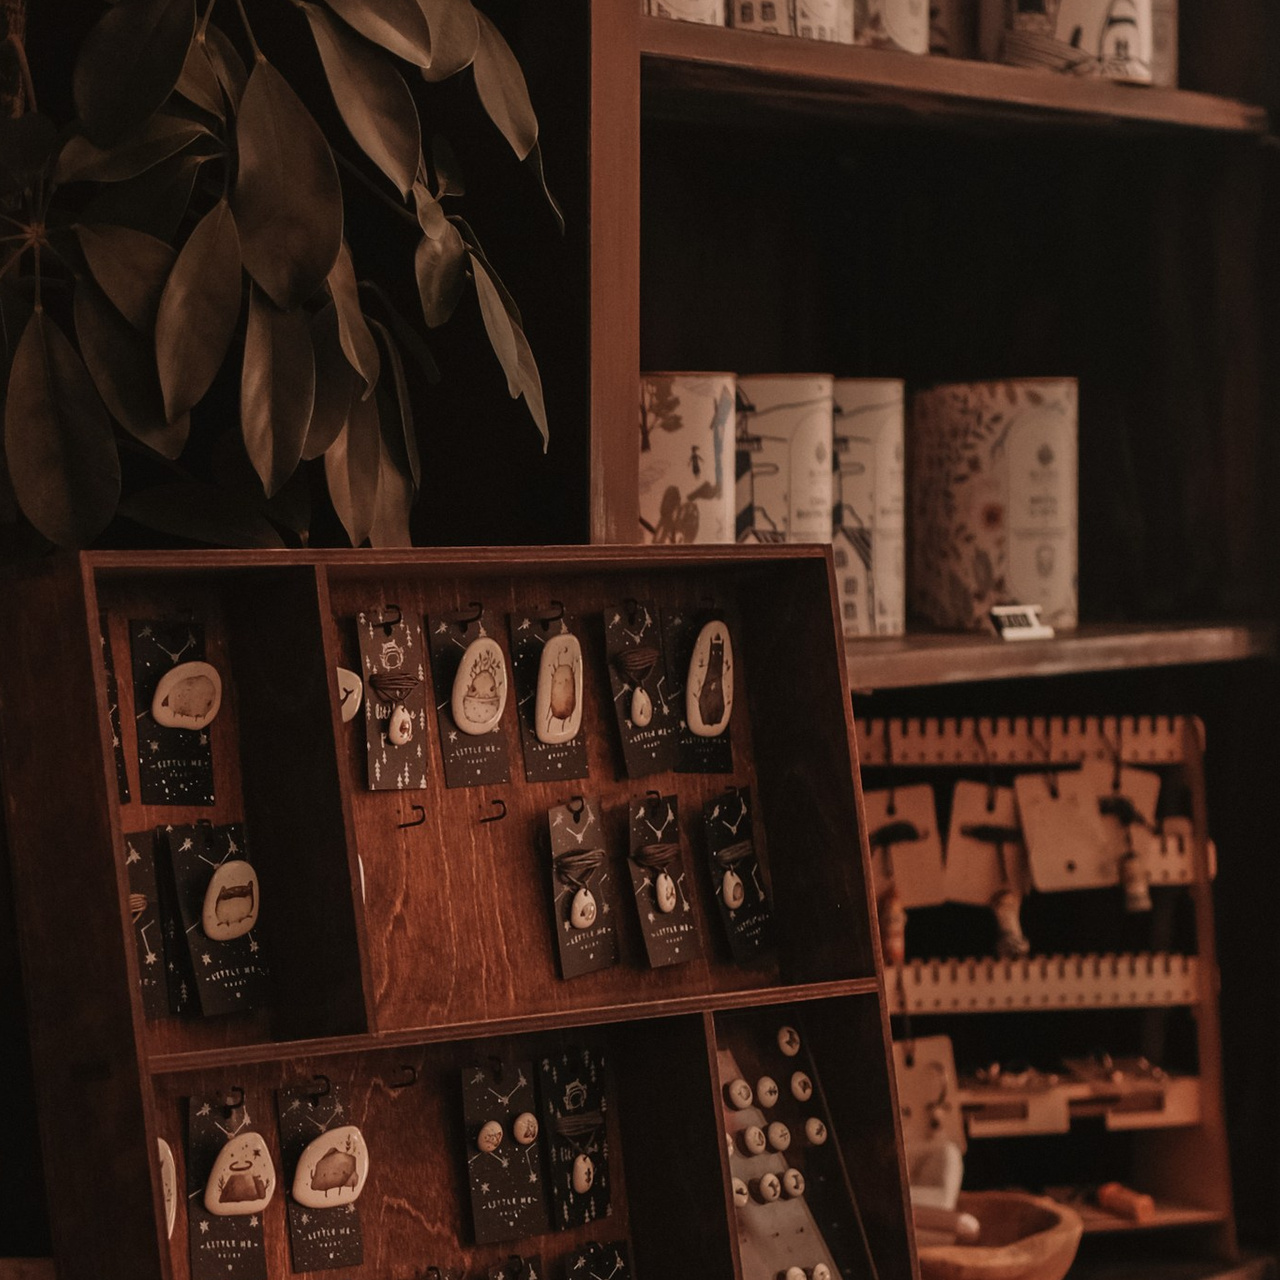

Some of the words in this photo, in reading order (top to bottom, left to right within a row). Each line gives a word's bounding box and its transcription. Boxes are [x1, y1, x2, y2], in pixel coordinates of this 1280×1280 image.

[456, 746, 481, 757] LITTLE
[308, 1227, 336, 1240] LITTLE
[206, 1240, 236, 1249] LITTLE
